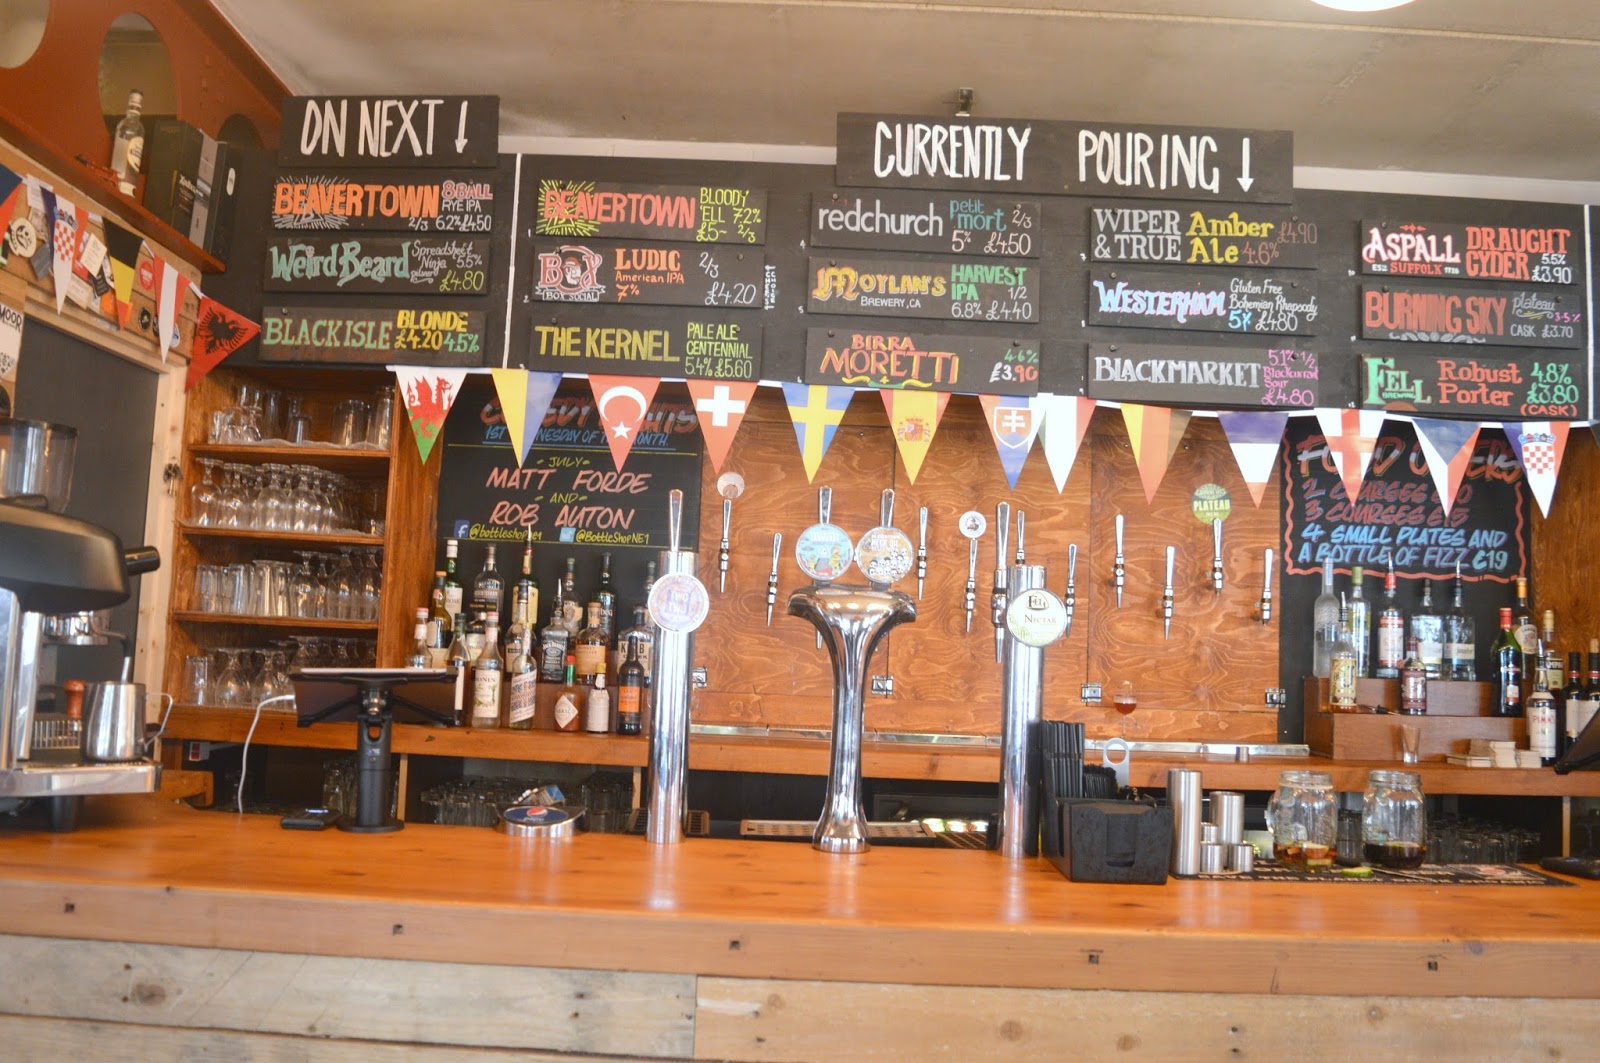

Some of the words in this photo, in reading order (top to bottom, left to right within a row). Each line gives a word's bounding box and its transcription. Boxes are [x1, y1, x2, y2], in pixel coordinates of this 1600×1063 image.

[301, 100, 347, 157] ON
[358, 100, 444, 157] NEXT
[874, 121, 1031, 181] CURRENTLY
[1079, 129, 1219, 193] POURING
[274, 183, 440, 218] BEAVERTOWN
[442, 200, 464, 212] RYE
[466, 200, 482, 213] IPA
[700, 187, 749, 207] BLOODY
[544, 190, 696, 229] BEAVERTOWN
[733, 208, 762, 224] 7.2%
[818, 199, 943, 236] redchurch
[950, 199, 984, 219] petit
[1012, 209, 1032, 229] 2/3
[957, 209, 1007, 231] mort
[737, 224, 756, 243] 2/3
[1093, 208, 1182, 236] WIPER
[1185, 211, 1275, 238] Amber
[411, 239, 473, 261] Spreadsheet
[984, 231, 1031, 255] £4.50
[1093, 234, 1111, 259] &
[1114, 235, 1182, 261] TRUE
[1186, 237, 1239, 264] Ale
[1362, 227, 1461, 264] ASPALL
[1465, 226, 1571, 254] DRAUGHT
[420, 255, 447, 276] Ninja
[615, 248, 681, 271] LUDIC
[699, 252, 719, 278] 2/3
[1389, 261, 1443, 275] SUFFOLK
[1465, 250, 1530, 281] CYDER
[439, 269, 485, 292] £4.80
[616, 270, 665, 283] American
[666, 271, 684, 284] IPA
[951, 264, 1027, 286] HARVEST
[1230, 278, 1262, 294] Gluten
[1263, 278, 1283, 295] Free
[1531, 266, 1573, 284] £3.90
[545, 291, 565, 301] BOX
[569, 291, 597, 302] SOCIAL
[615, 283, 640, 302] 7%
[704, 282, 757, 305] £4.20
[951, 284, 980, 301] IPA
[1008, 286, 1028, 300] 1/2
[1093, 280, 1226, 324] WESTERHAM
[951, 302, 983, 319] 6.8%
[985, 300, 1032, 321] £4.40
[1229, 294, 1274, 311] Bohemian
[1275, 295, 1318, 322] Rhapsody
[1365, 290, 1464, 334] BURNING
[1465, 296, 1507, 336] SKY
[397, 309, 469, 333] BLONDE
[687, 322, 714, 340] PALE
[716, 323, 738, 341] ALE
[1255, 310, 1298, 331] £4.80
[1510, 324, 1536, 338] CASK
[1541, 324, 1574, 338] £3.70
[394, 330, 443, 350] £4.20
[443, 334, 480, 353] 4.5%
[535, 325, 581, 357] THE
[586, 327, 681, 363] KERNEL
[686, 341, 753, 360] CENTENNIAL
[851, 334, 915, 351] BIRRA
[819, 347, 959, 384] MORETTI
[1092, 356, 1261, 388] BLACKMARKET
[1437, 359, 1523, 384] Robust
[1530, 362, 1572, 385] 4.8%
[1261, 388, 1315, 406] £4.80
[1437, 382, 1514, 407] Porter
[1526, 384, 1579, 405] £3.80
[1520, 404, 1578, 417] (CASK)
[582, 430, 598, 443] OF
[485, 467, 557, 490] MATT
[572, 469, 652, 494] FORDE
[1302, 479, 1326, 500] 2
[489, 501, 540, 527] ROB
[554, 505, 635, 529] AUTON
[1304, 500, 1324, 523] 3
[1325, 503, 1426, 527] COURSES
[1302, 523, 1325, 543] 4
[1330, 525, 1392, 545] SMALL
[1396, 526, 1467, 548] PLATES
[1468, 529, 1508, 549] AND
[1297, 545, 1312, 563] A
[1315, 545, 1389, 565] BOTTLE
[1394, 548, 1418, 566] OF
[1422, 548, 1470, 569] FIZZ
